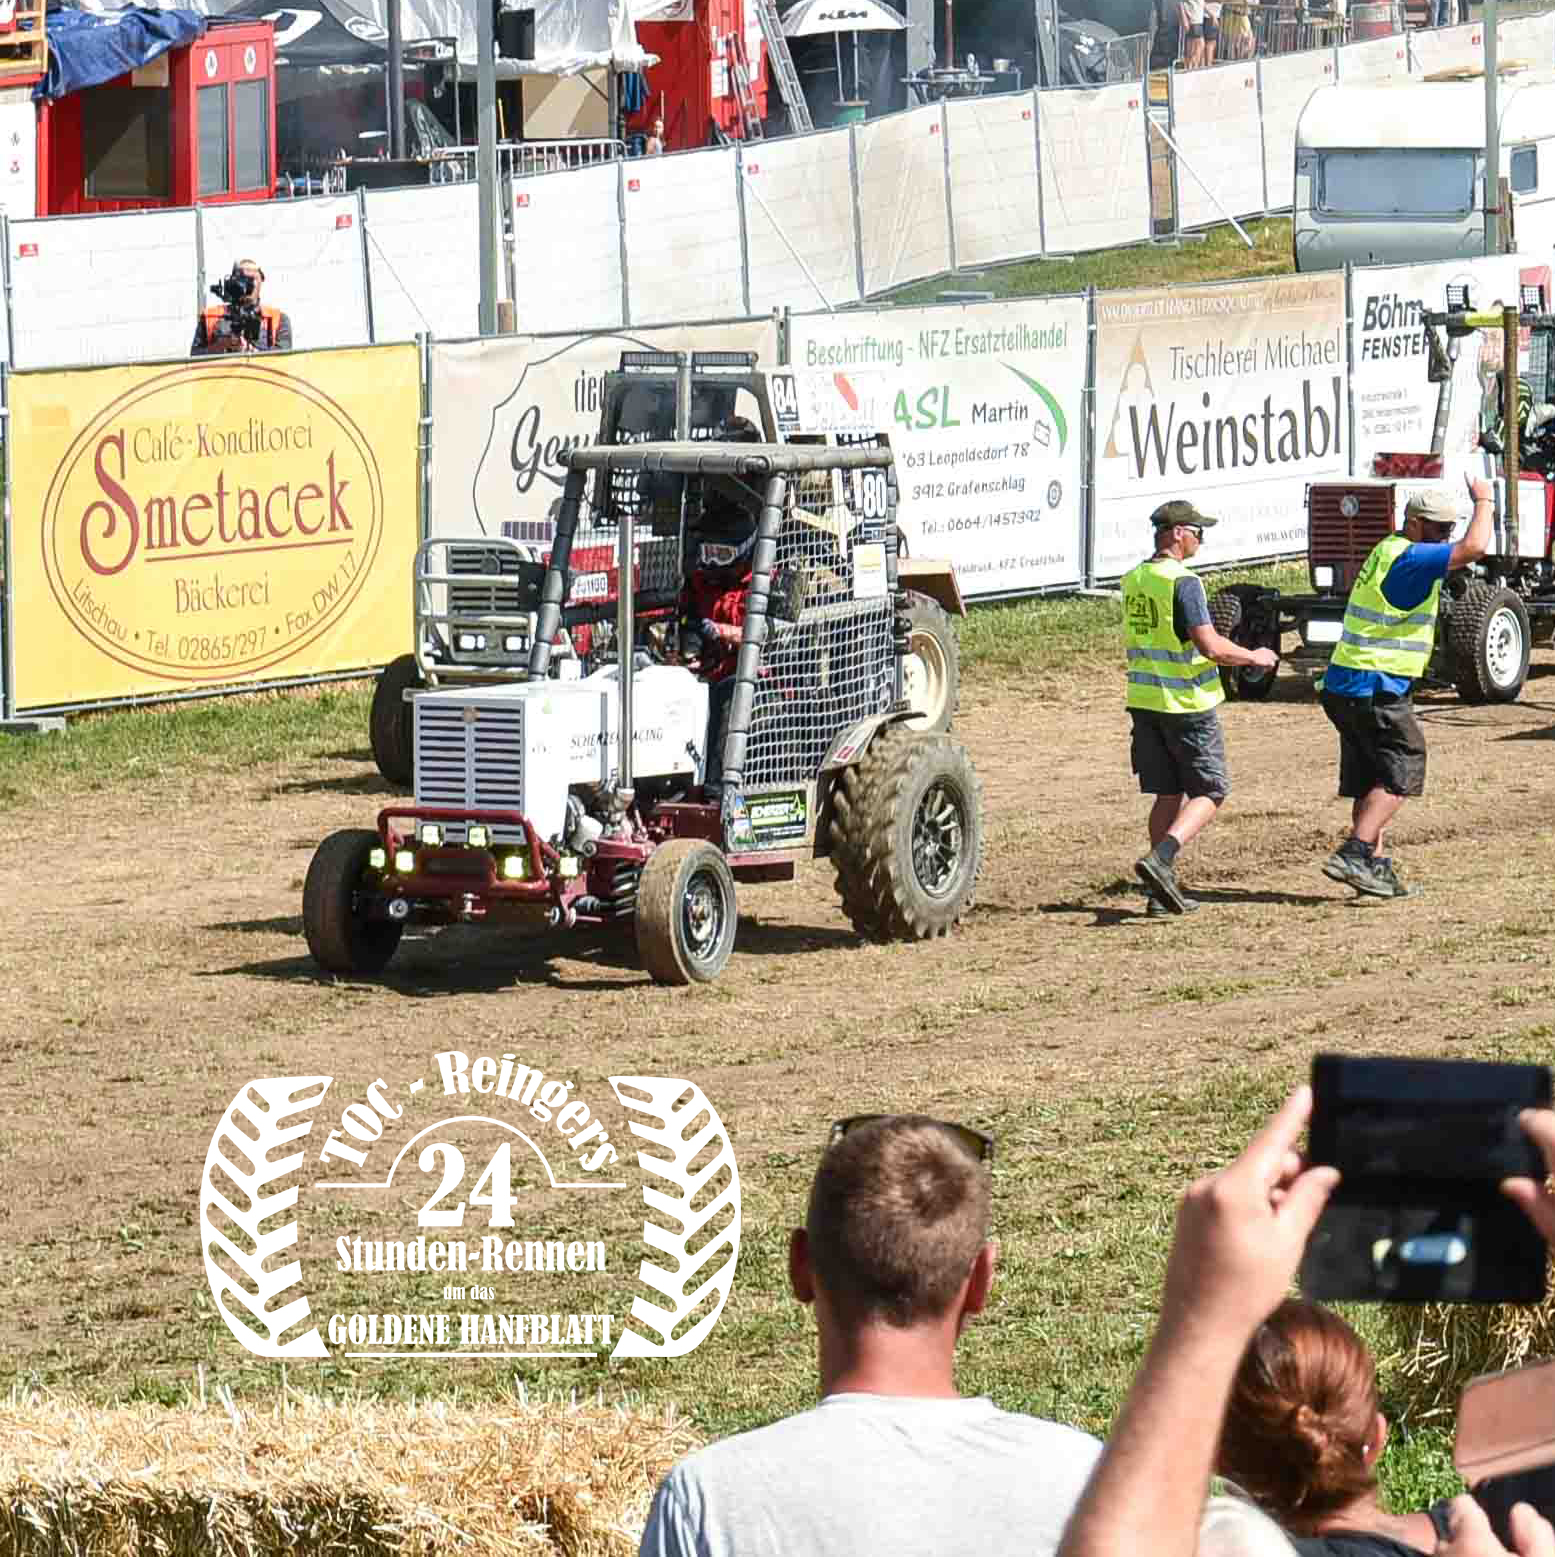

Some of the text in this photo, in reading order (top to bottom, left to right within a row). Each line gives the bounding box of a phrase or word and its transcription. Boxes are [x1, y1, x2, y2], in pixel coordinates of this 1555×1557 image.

[1363, 293, 1424, 331] Böhm
[807, 334, 904, 367] Beschriftung
[919, 328, 949, 360] NFZ
[954, 321, 1069, 356] Ersatzteilhandel
[1169, 323, 1341, 381] Tischlerei Michael
[893, 385, 961, 431] ASL
[971, 400, 1029, 425] Martin
[1128, 376, 1342, 479] Weinstabl
[929, 444, 1009, 467] Leopoldsdorf
[1013, 442, 1031, 458] 78
[79, 427, 354, 576] Smetacek
[863, 473, 887, 518] 80
[912, 475, 1026, 500] 3912 Grafenschlag
[947, 508, 1041, 532] 0664/1457392
[70, 576, 129, 643] Litschau
[177, 626, 268, 662] 02865/297
[311, 583, 342, 617] DW
[338, 549, 358, 582] 17
[175, 571, 271, 615] Bäckerei
